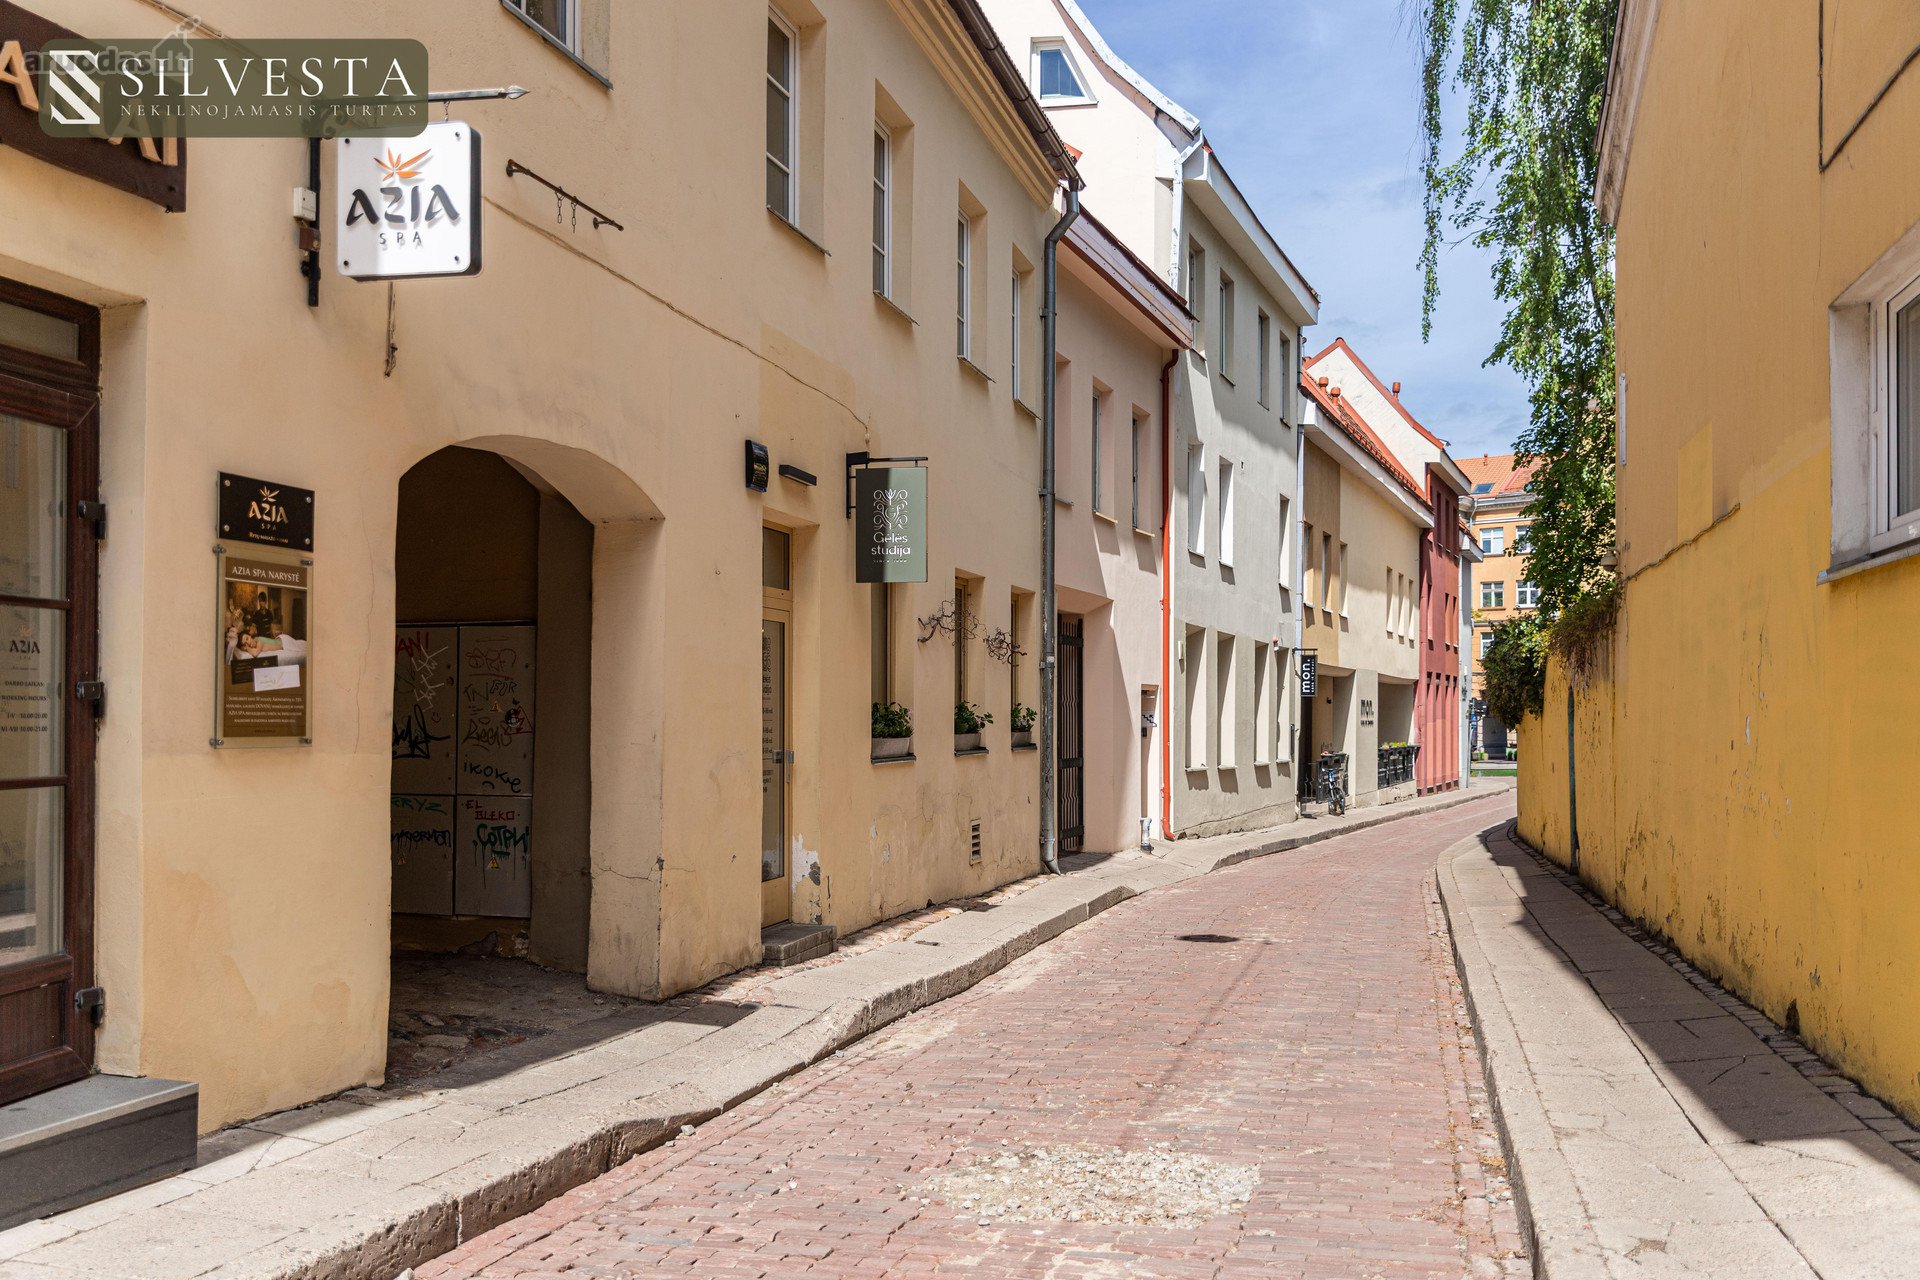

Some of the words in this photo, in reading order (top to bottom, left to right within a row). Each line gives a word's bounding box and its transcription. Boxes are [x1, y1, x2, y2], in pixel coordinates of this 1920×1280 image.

[346, 184, 460, 226] AZIA
[380, 231, 422, 244] SPA
[247, 500, 289, 524] AZIA
[260, 523, 277, 531] SPA
[873, 531, 908, 543] Gėlės
[871, 545, 911, 557] studija
[231, 566, 251, 576] AZIA
[252, 568, 267, 578] SPA
[268, 570, 301, 583] NARYSTĖ
[9, 639, 41, 654] AZIA
[1302, 658, 1311, 693] mon.
